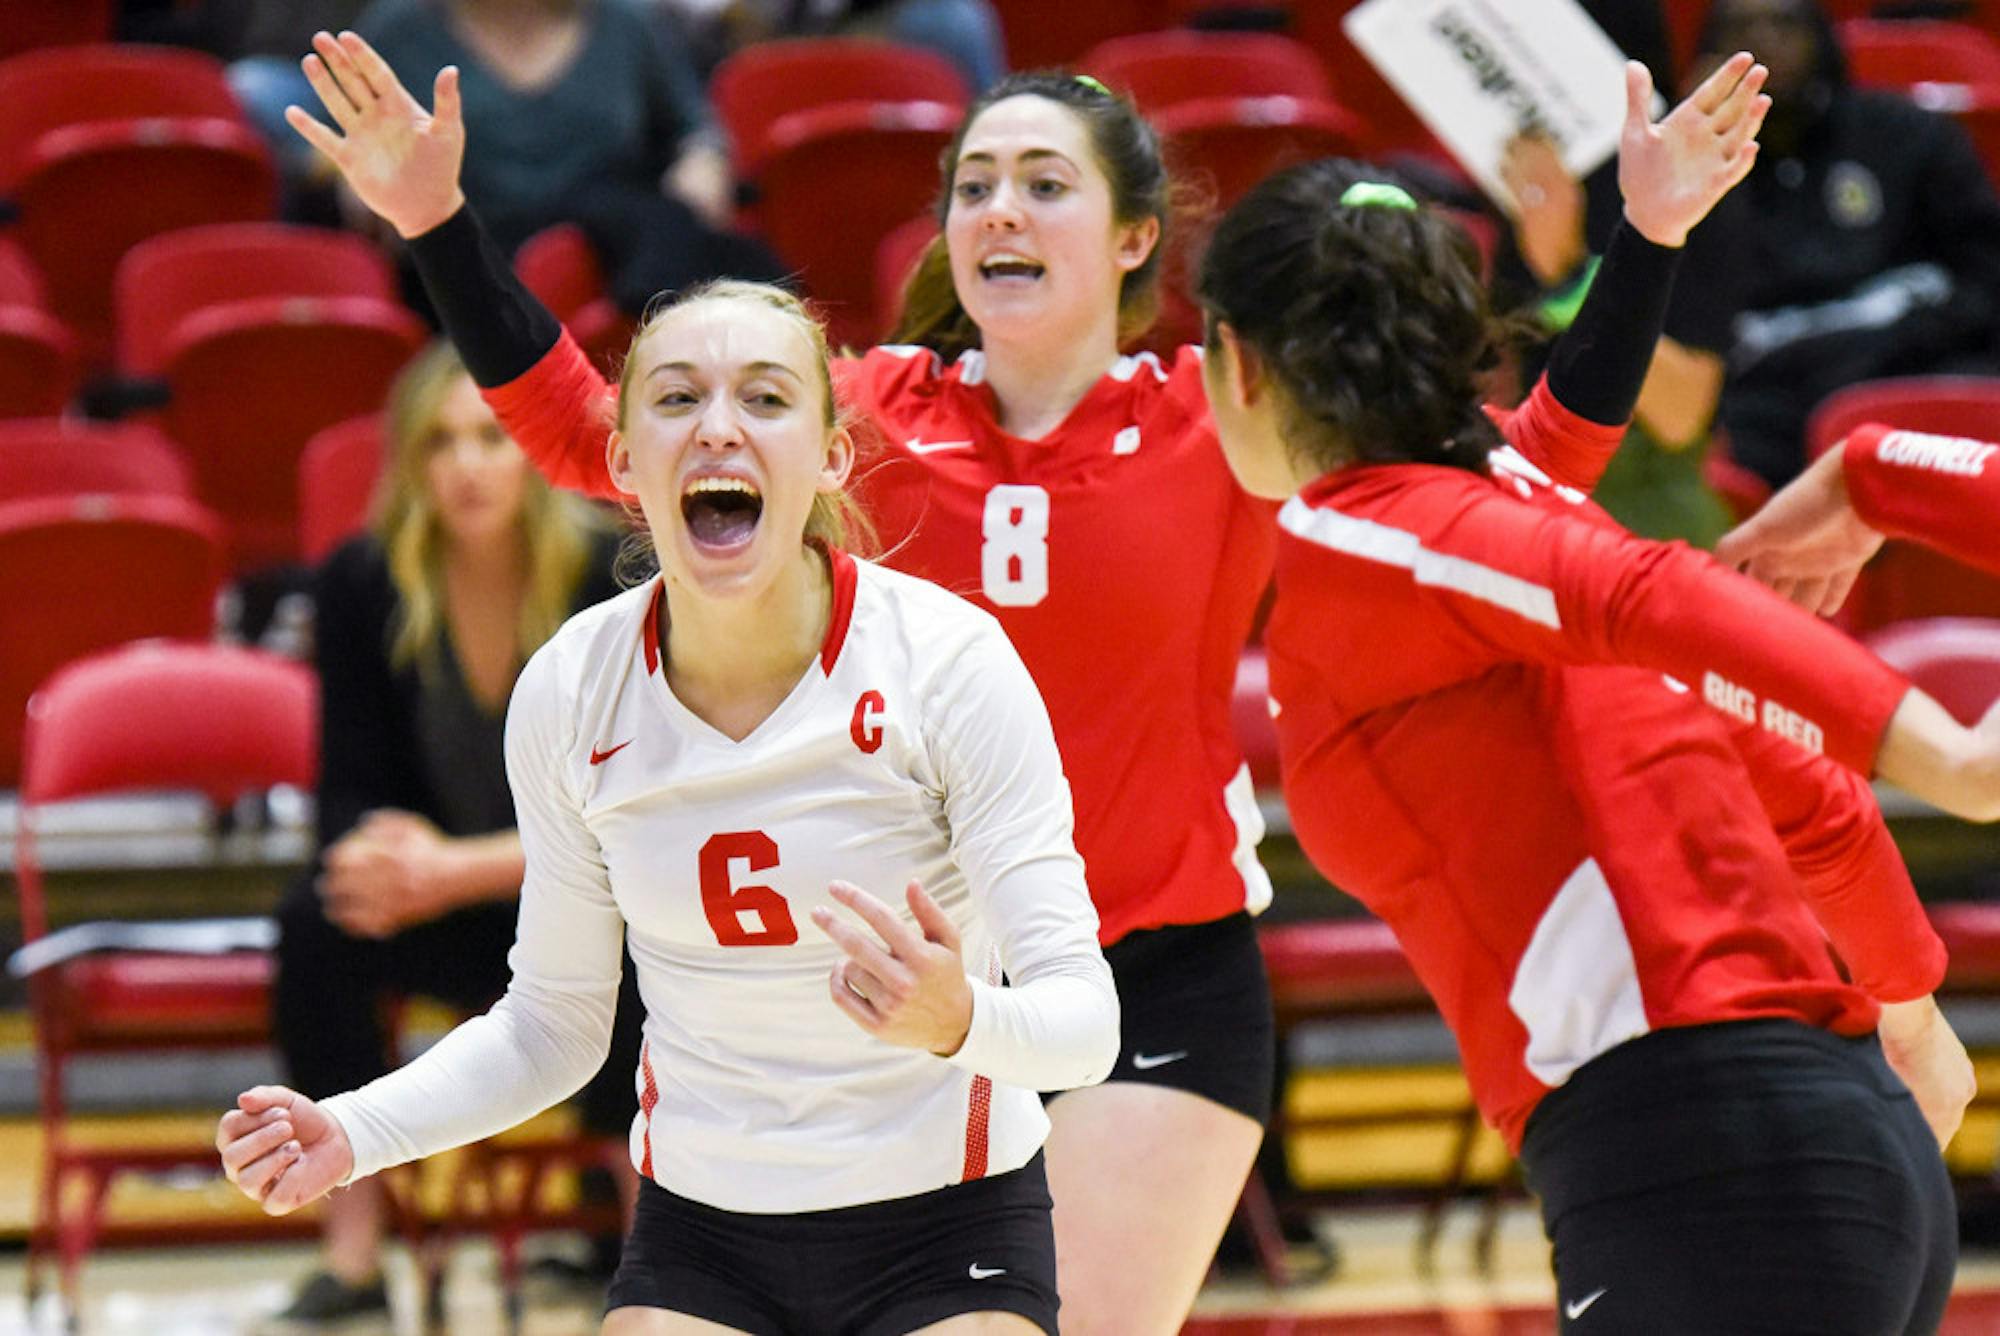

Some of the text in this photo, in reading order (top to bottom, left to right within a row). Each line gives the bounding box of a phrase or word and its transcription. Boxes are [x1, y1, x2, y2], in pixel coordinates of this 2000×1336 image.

[981, 483, 1051, 607] 8
[850, 690, 885, 755] C
[1703, 670, 1824, 754] BIG RED
[698, 830, 799, 947] 6
